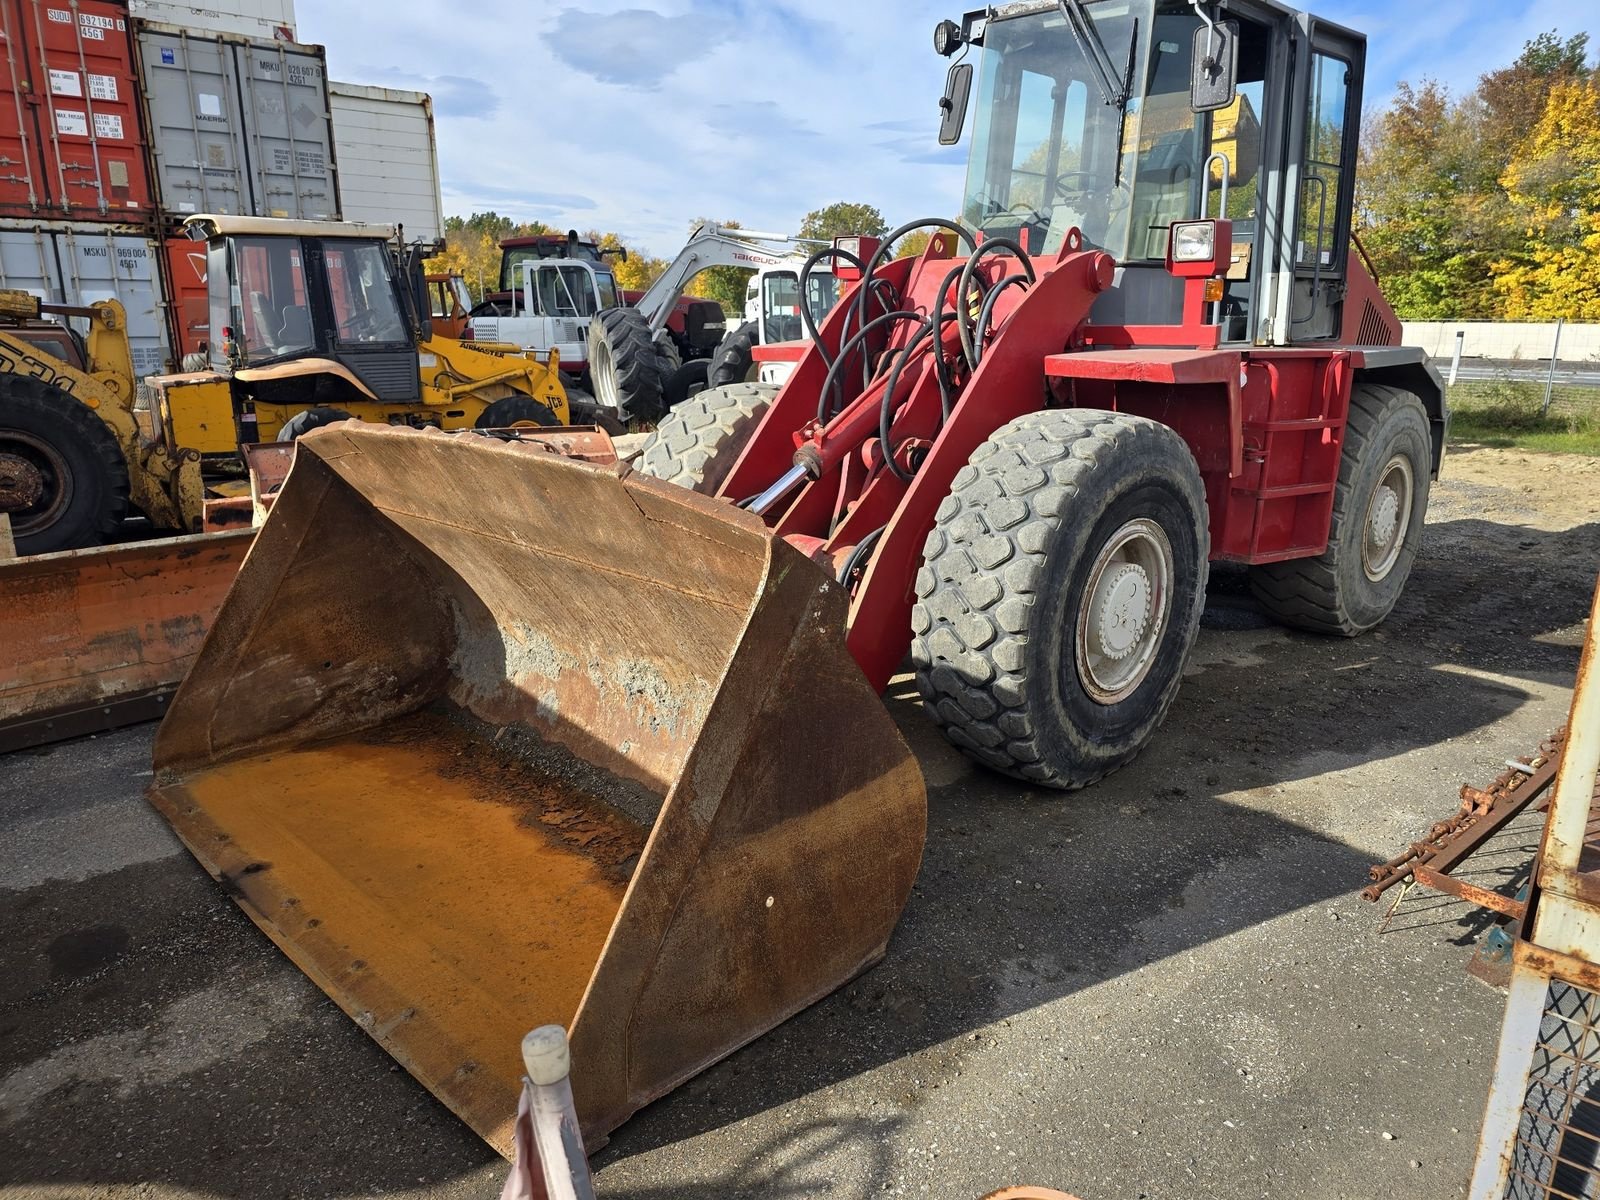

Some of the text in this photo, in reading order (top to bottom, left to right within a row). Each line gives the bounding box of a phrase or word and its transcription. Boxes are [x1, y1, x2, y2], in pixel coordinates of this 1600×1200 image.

[48, 10, 124, 30] SUDU 692194 8
[82, 28, 104, 39] 45G1
[259, 60, 280, 72] MRKU
[289, 74, 306, 85] 42G1
[195, 115, 228, 123] MAERSK
[83, 247, 107, 257] MSKU
[119, 259, 138, 269] 45G1
[459, 341, 505, 359] AIRMASTER
[546, 395, 563, 411] JCB
